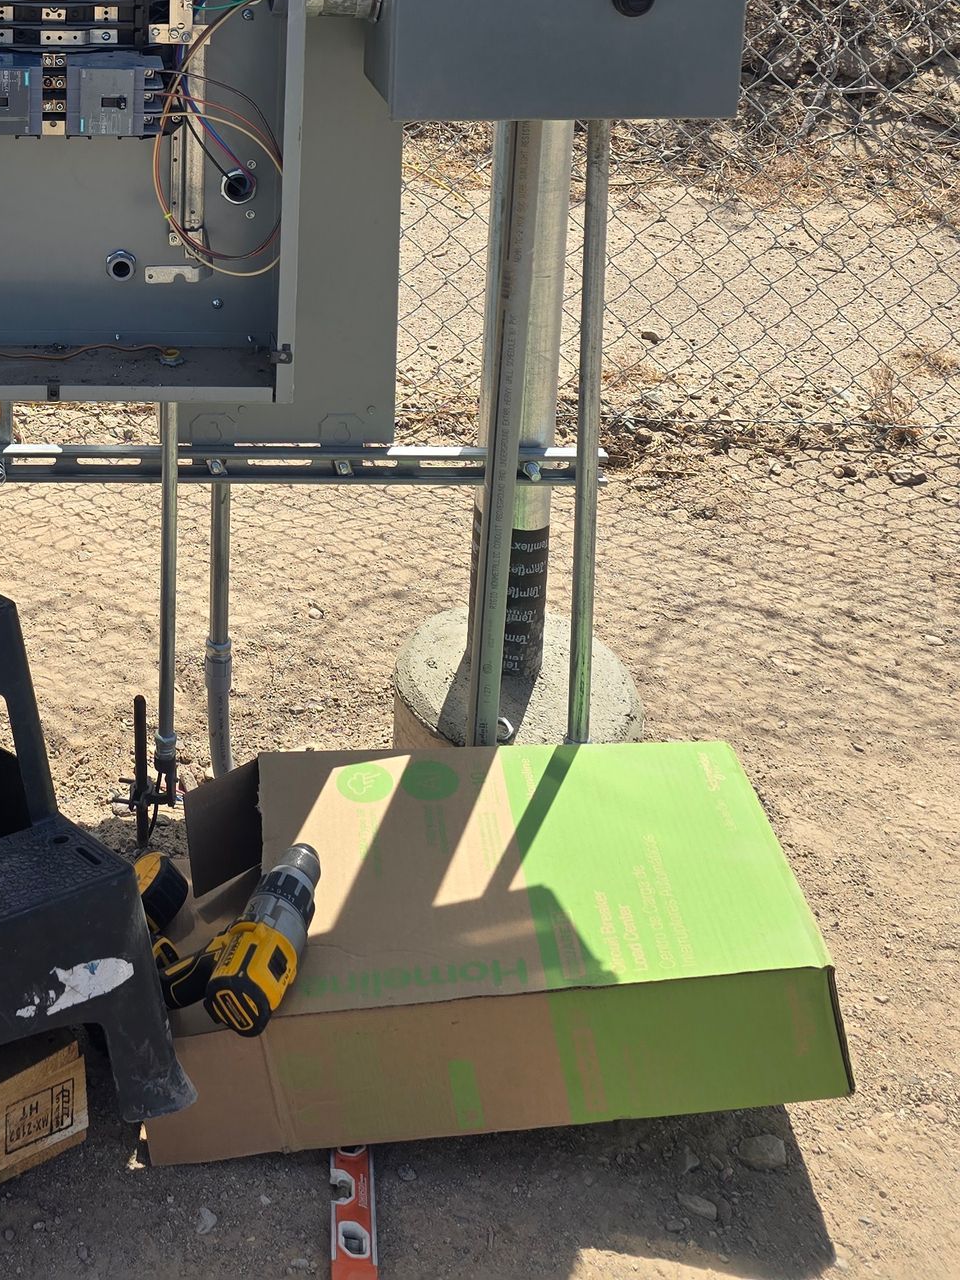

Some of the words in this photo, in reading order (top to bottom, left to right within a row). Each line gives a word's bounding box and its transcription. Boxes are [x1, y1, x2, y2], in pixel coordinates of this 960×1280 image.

[487, 591, 498, 609] RIGID
[594, 889, 617, 934] Breaker
[640, 881, 659, 913] Carga
[618, 904, 640, 940] Center
[650, 915, 662, 929] de
[666, 898, 696, 968] Interruptores
[603, 935, 626, 974] Circuit
[626, 942, 648, 971] Load
[655, 932, 676, 969] Centro
[301, 958, 529, 999] Homeline
[20, 1101, 39, 1121] HT
